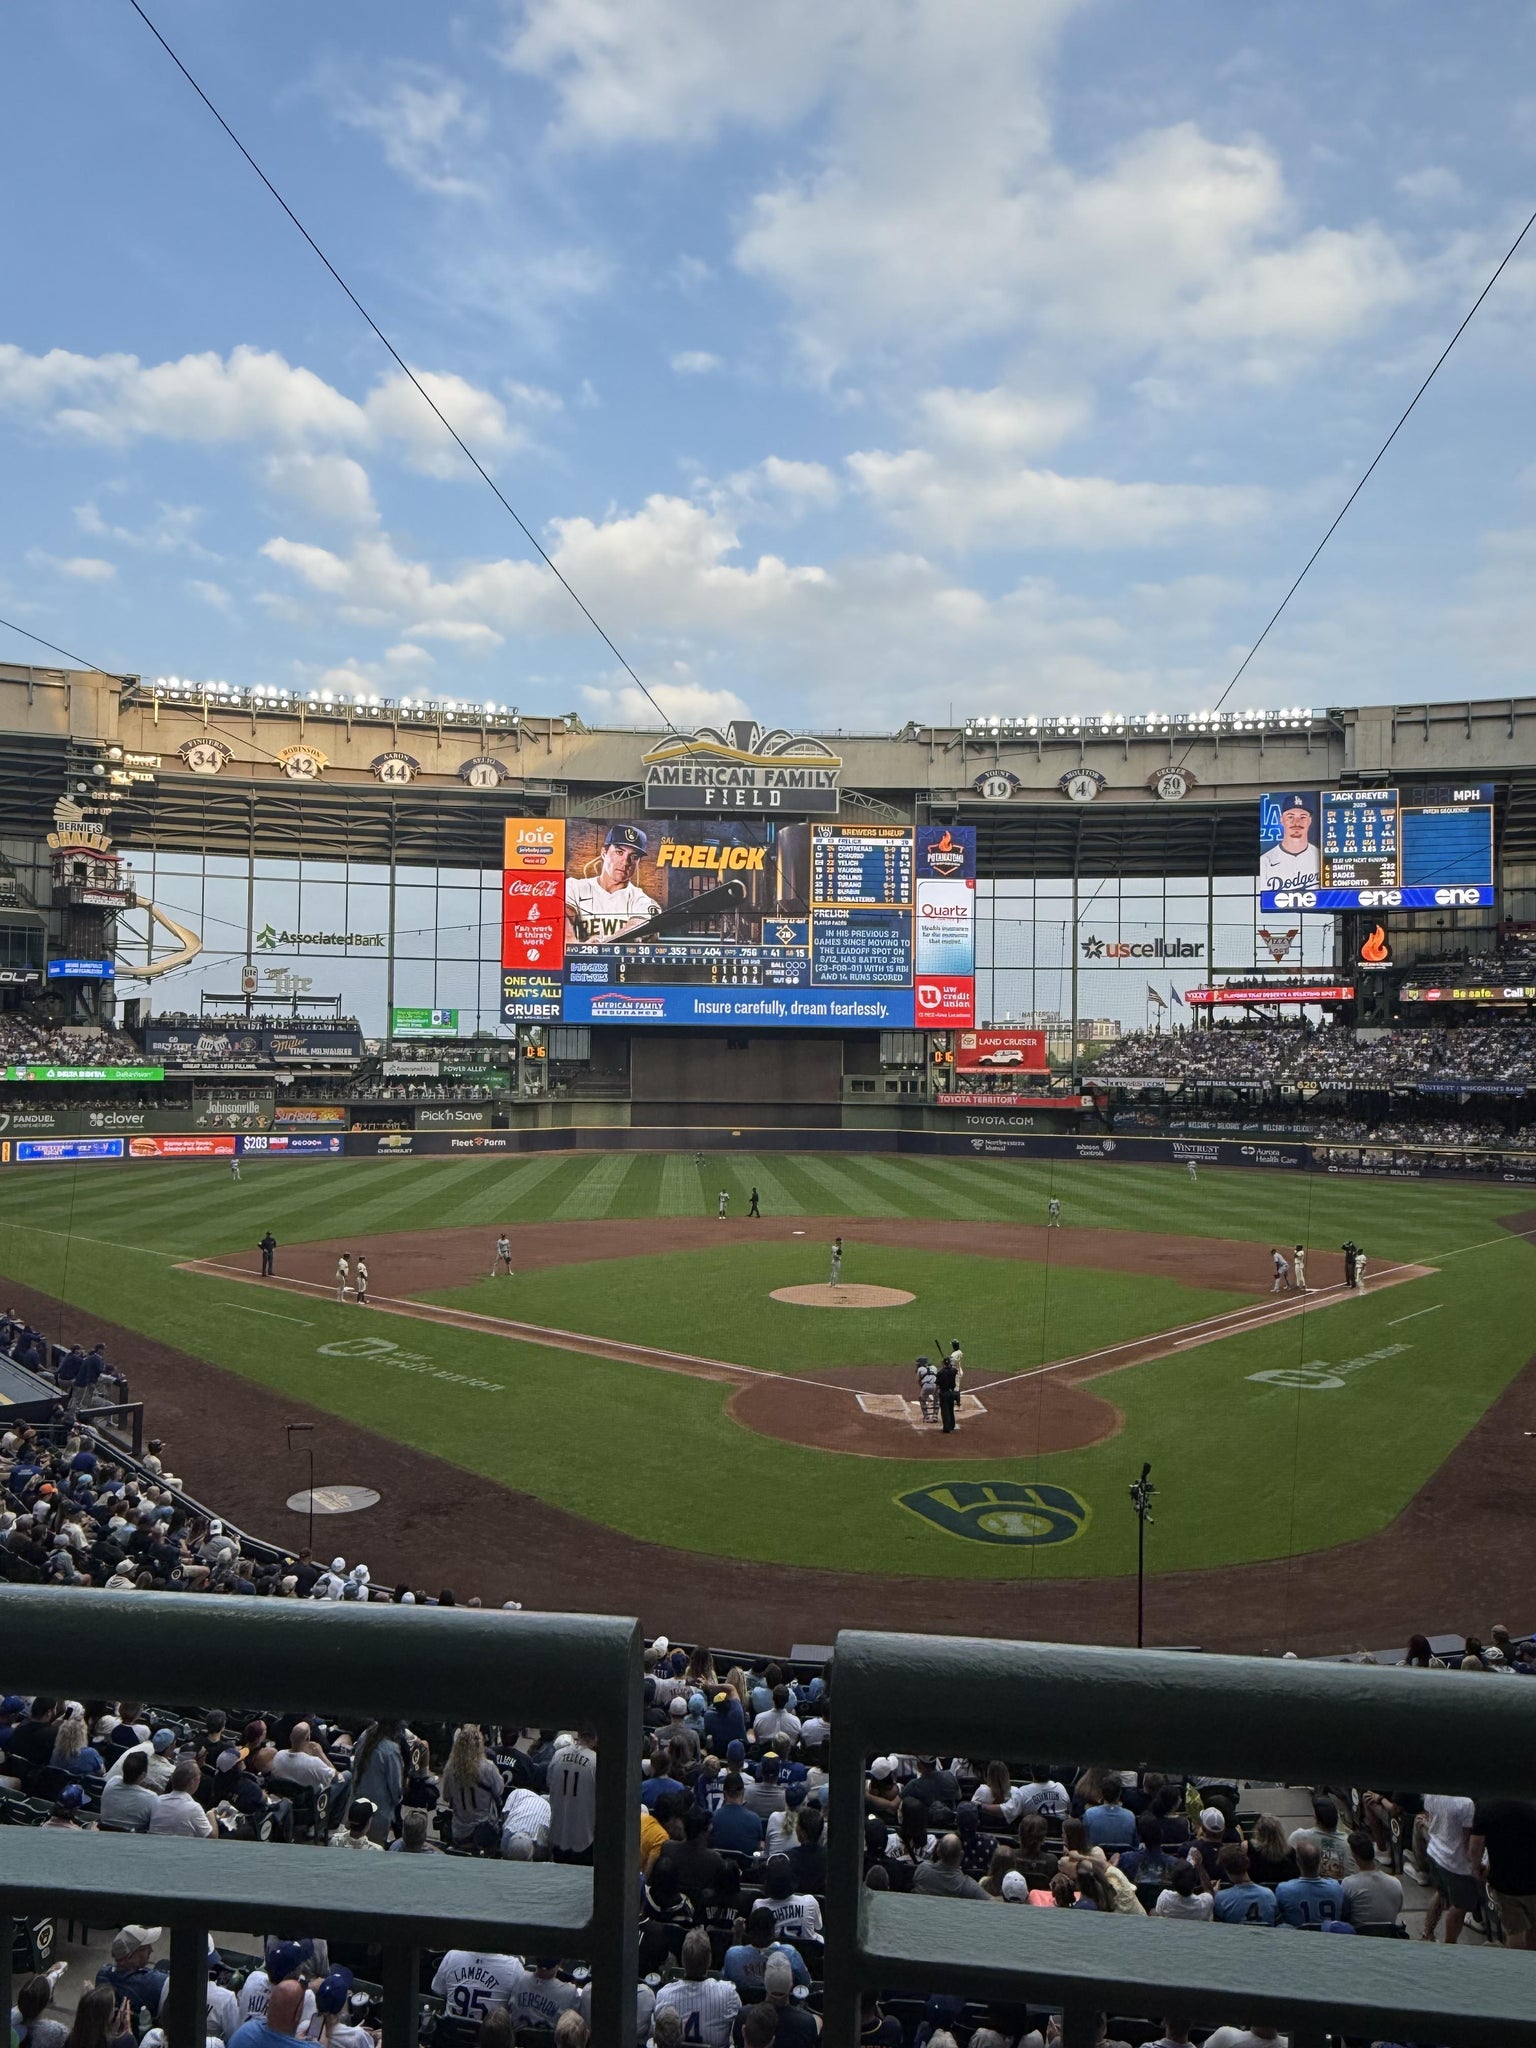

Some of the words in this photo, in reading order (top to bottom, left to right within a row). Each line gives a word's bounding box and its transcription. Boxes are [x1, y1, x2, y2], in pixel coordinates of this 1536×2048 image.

[188, 738, 223, 750] FINGERS
[283, 747, 321, 758] ROBINSON
[384, 753, 409, 761] AARON
[193, 751, 217, 767] 34
[291, 758, 313, 774] 42
[384, 765, 407, 781] 44
[479, 770, 488, 785] 1
[648, 766, 755, 787] AMERICAN
[764, 769, 838, 789] FAMILY
[985, 770, 1009, 778] YOUNT
[1066, 771, 1099, 780] MOLITOR
[1164, 776, 1180, 790] 50
[987, 782, 1007, 797] 19
[1076, 781, 1086, 797] 4
[705, 788, 781, 806] FIELD
[1331, 793, 1353, 801] JACK
[1356, 792, 1388, 800] DREYER
[1454, 790, 1480, 801] MPH
[100, 807, 112, 816] UP
[58, 822, 102, 833] BERNIE'S
[879, 829, 904, 837] LINEUP
[516, 827, 554, 844] Joie
[661, 836, 675, 845] SAL
[46, 832, 112, 852] CHALET
[656, 844, 768, 870] FRELICK
[509, 880, 559, 897] Coca-Cola
[814, 909, 849, 918] FRELICK
[922, 904, 968, 918] Quartz
[525, 932, 552, 940] thirsty
[579, 946, 598, 955] .296
[614, 946, 620, 955] 6
[638, 946, 650, 955] 30
[668, 947, 687, 955] .352
[702, 947, 721, 956] .404
[771, 949, 779, 957] 41
[796, 949, 805, 957] 15
[504, 977, 526, 985] ONE
[821, 972, 837, 980] AND
[504, 988, 539, 998] THAT'S
[1453, 989, 1466, 997] Be
[1469, 989, 1494, 998] safe.
[1504, 988, 1523, 998] Call
[505, 1004, 559, 1016] GRUBER
[694, 999, 731, 1014] Insure
[734, 1000, 788, 1017] carefully,
[791, 1001, 827, 1015] dream
[830, 1001, 889, 1018] fearlessly.
[979, 1038, 1001, 1046] LAND
[1297, 1081, 1317, 1090] 620
[1320, 1081, 1352, 1090] WTMJ
[1418, 1083, 1454, 1091] WINTRUST
[940, 1095, 971, 1103] TOYOTA
[973, 1096, 1018, 1104] TERRITORY
[206, 1101, 260, 1114] Johnsonville
[13, 1115, 55, 1123] FANDUEL
[104, 1112, 145, 1124] clover
[456, 1111, 482, 1121] Save
[966, 1115, 1034, 1126] TOYOTA.COM
[244, 1136, 267, 1150] $203
[452, 1139, 473, 1147] Fleet
[484, 1139, 506, 1147] Farm
[1173, 1143, 1219, 1153] WINTRUST
[561, 1753, 589, 1767] TELLEZ
[563, 1770, 579, 1797] 11
[706, 1792, 724, 1811] 17
[1303, 1900, 1336, 1922] 19
[454, 1966, 500, 1990] LAMBERT
[452, 1985, 492, 2020] 95
[684, 2012, 703, 2043] 4
